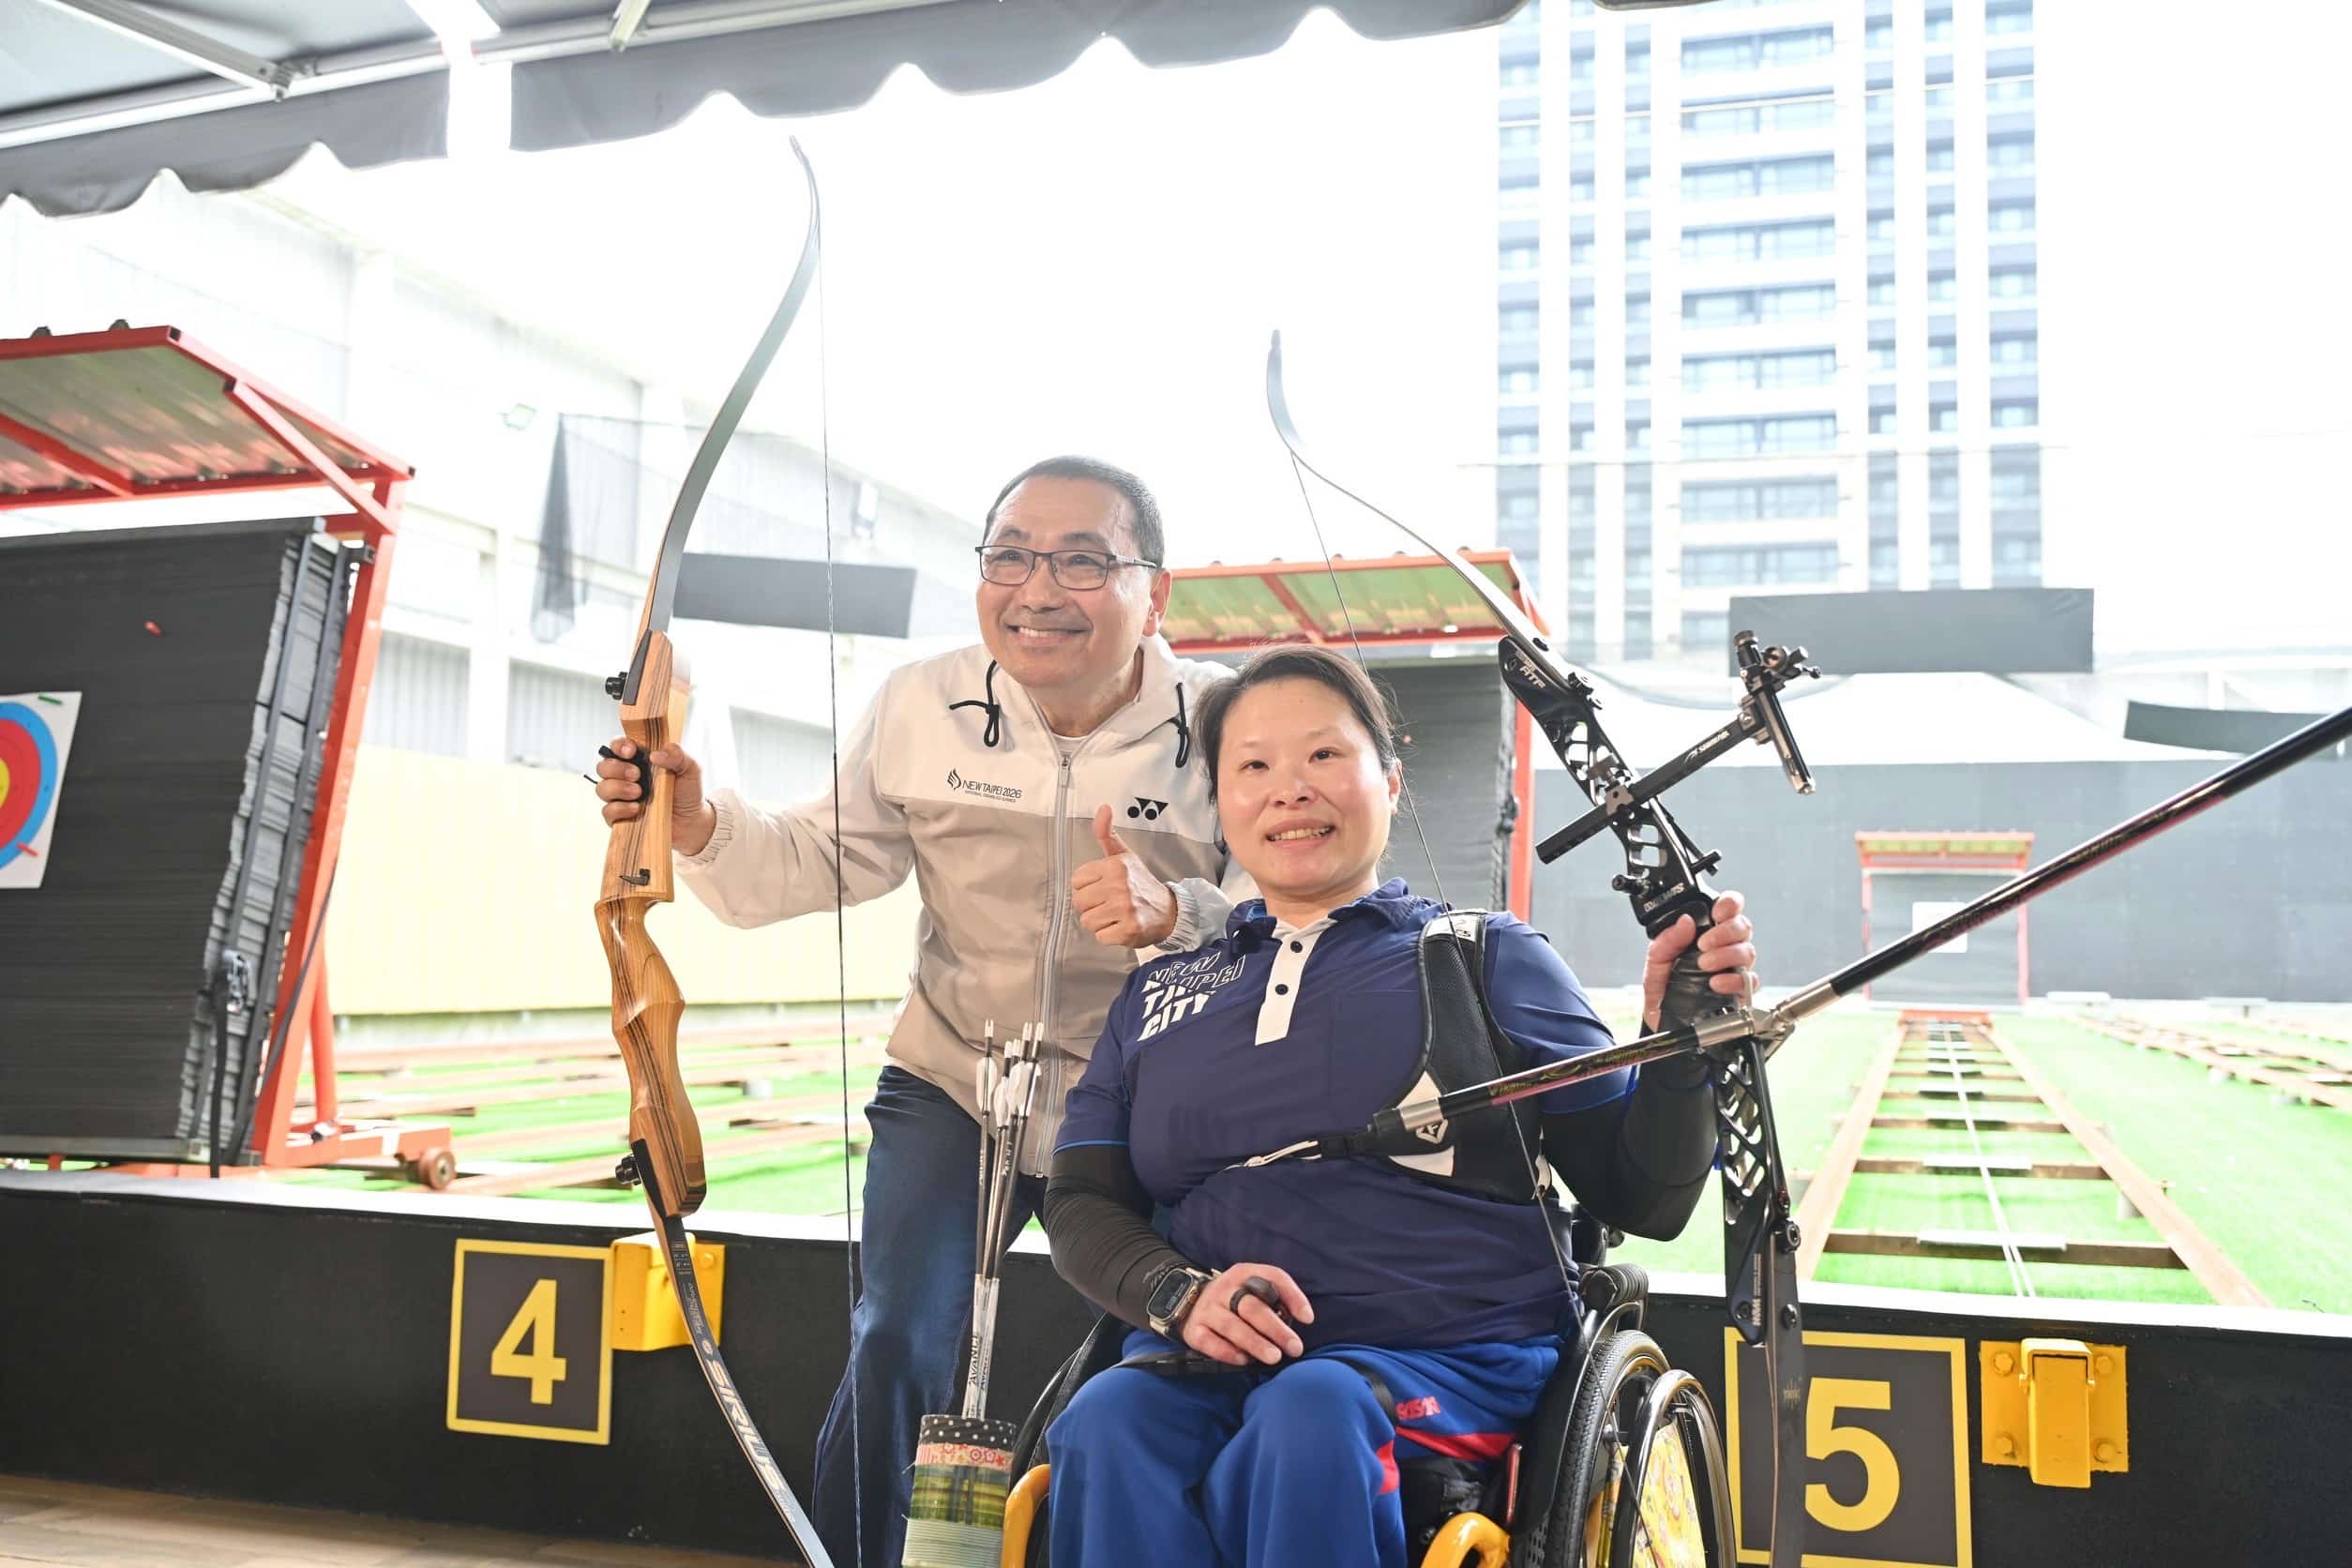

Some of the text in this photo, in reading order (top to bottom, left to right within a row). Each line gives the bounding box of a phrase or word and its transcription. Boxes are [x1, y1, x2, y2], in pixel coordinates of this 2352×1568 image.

[962, 779, 983, 792] NEW
[983, 782, 1003, 796] TAIPEI
[1003, 787, 1022, 799] 2026
[1141, 951, 1222, 993] NEW
[1137, 989, 1217, 1042] CITY
[490, 1279, 566, 1405] 4
[1804, 1377, 1901, 1532] 5
